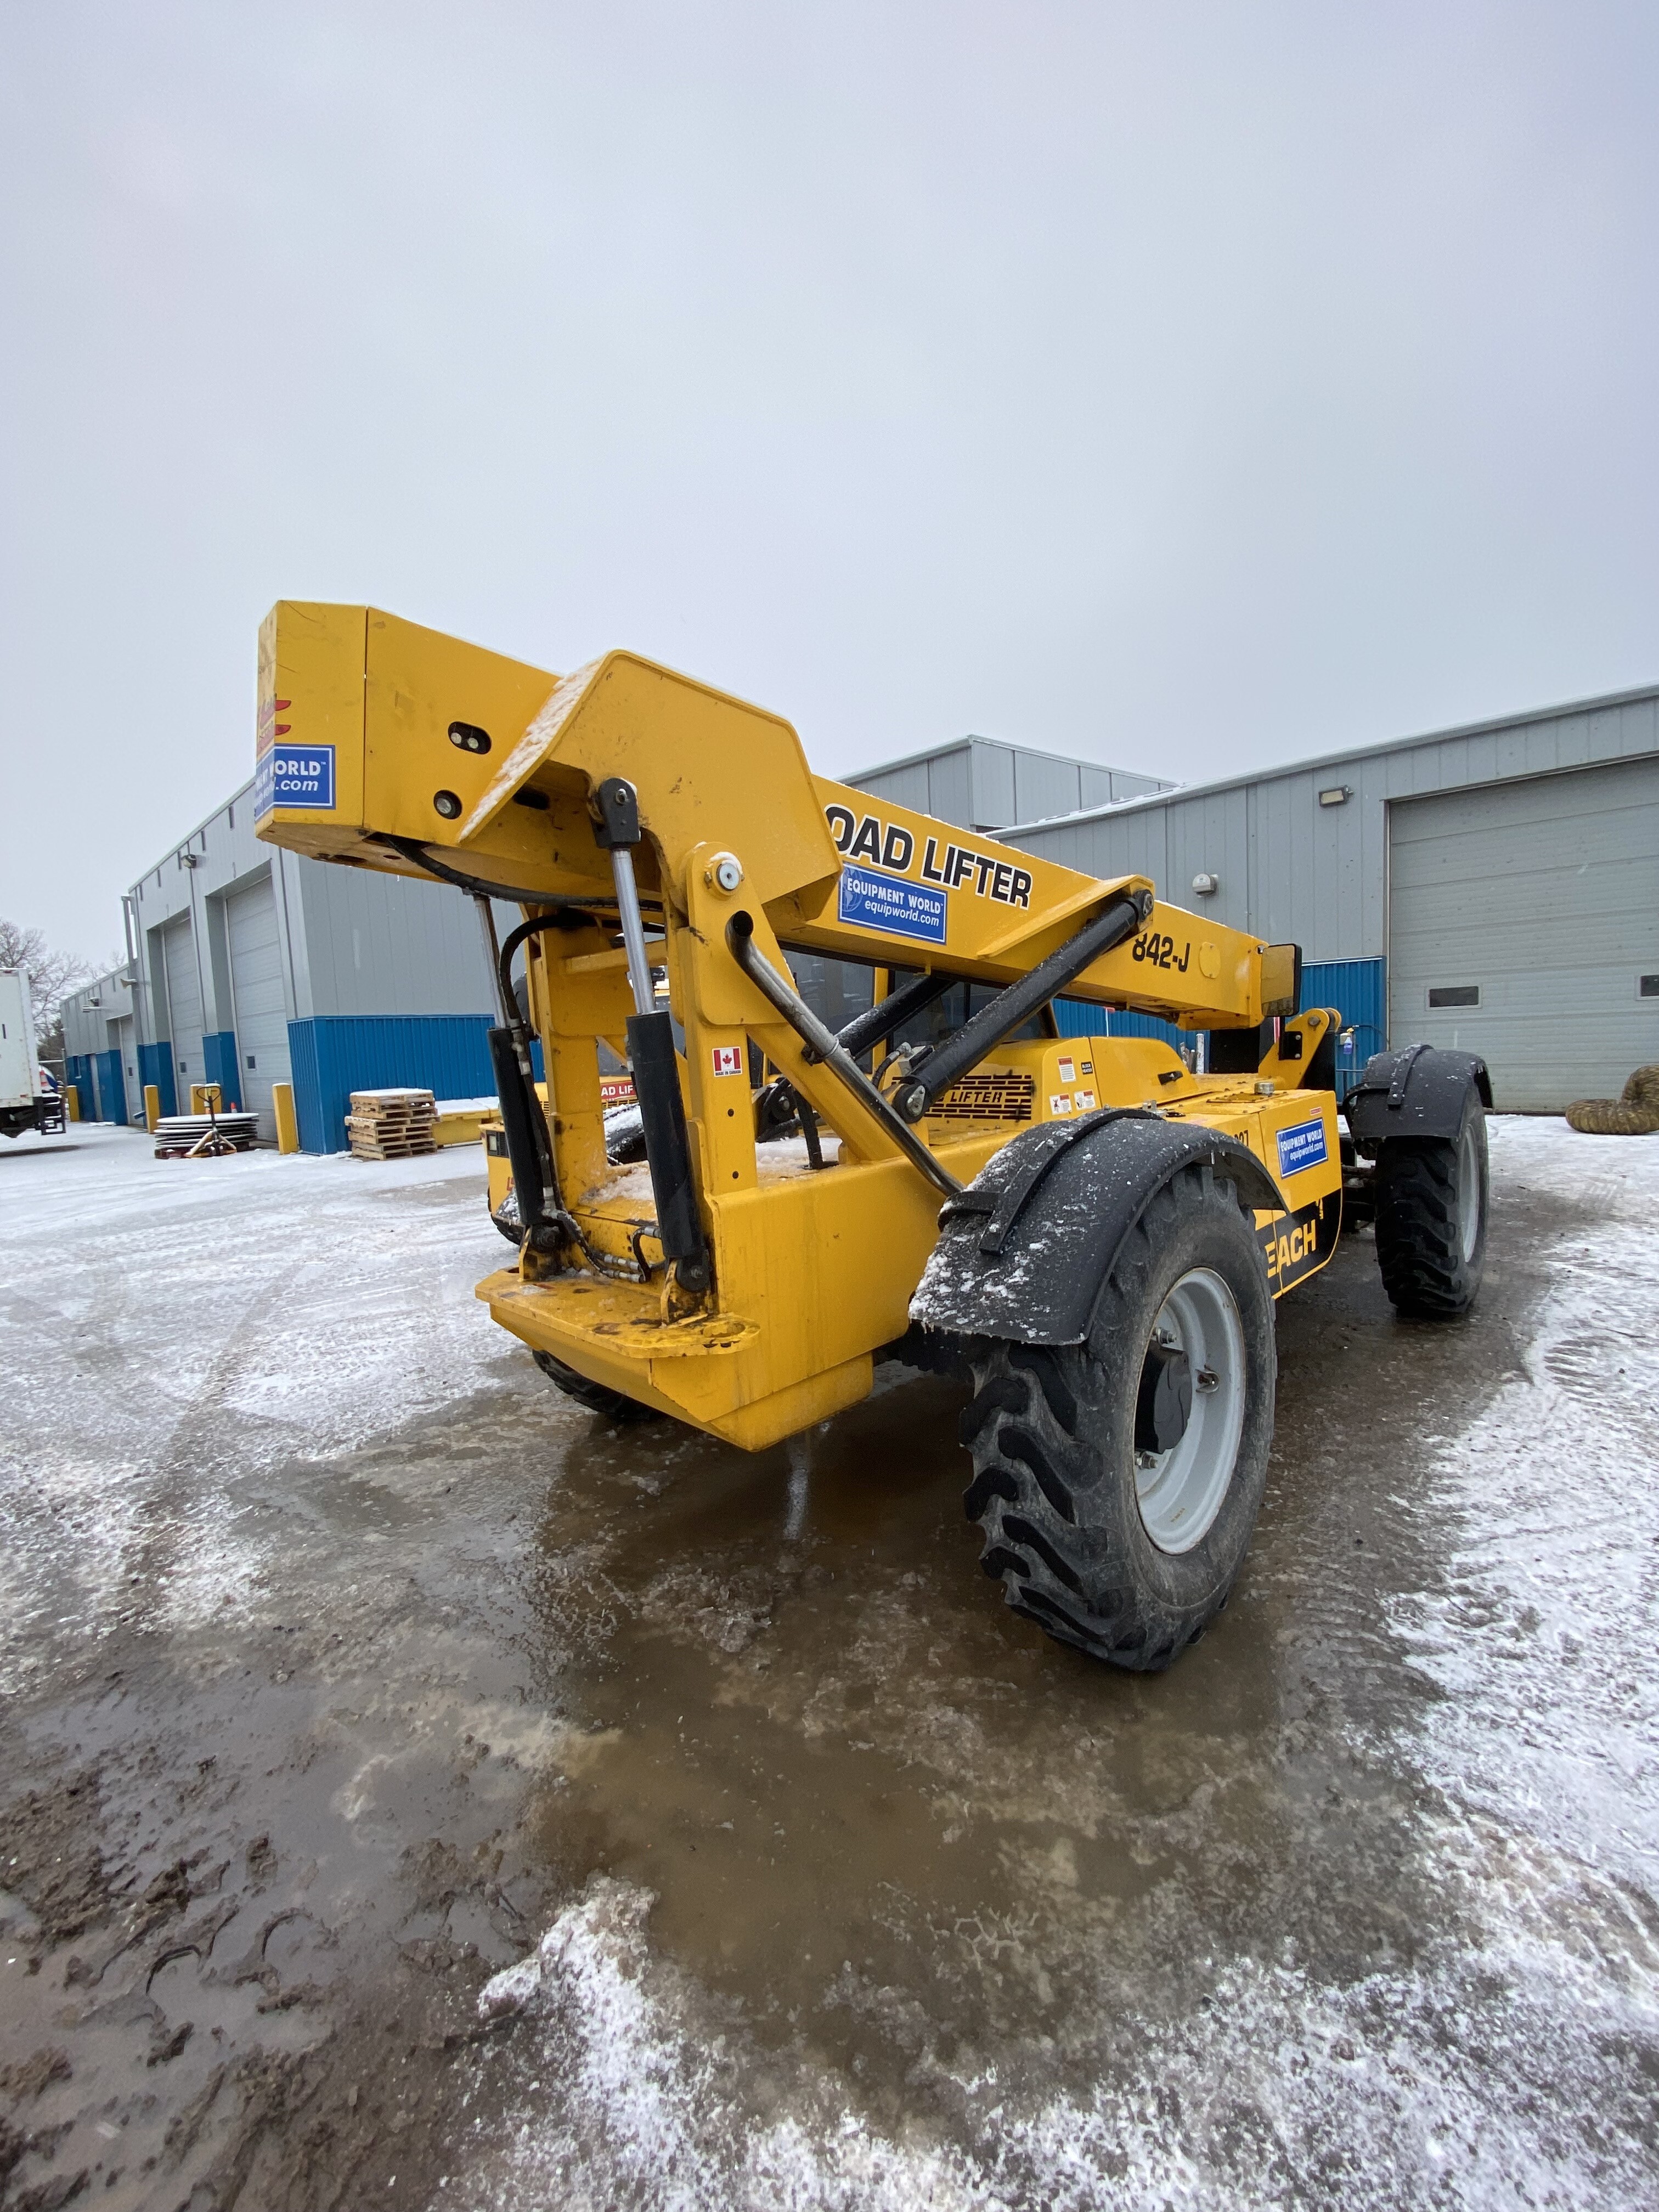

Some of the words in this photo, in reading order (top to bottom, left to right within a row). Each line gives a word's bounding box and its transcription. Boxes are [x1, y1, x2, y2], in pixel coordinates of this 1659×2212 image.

[921, 837, 1032, 910] LIFTER
[848, 878, 905, 905] EQUIPMENT
[865, 900, 940, 927] equipworld.com
[1132, 933, 1190, 972] 842-J
[601, 1086, 616, 1096] AD
[950, 1091, 1002, 1103] LIFTER
[1280, 1133, 1306, 1152] EQUIPMENT
[1290, 1141, 1323, 1161] equipworld.com
[1265, 1219, 1316, 1278] EACH
